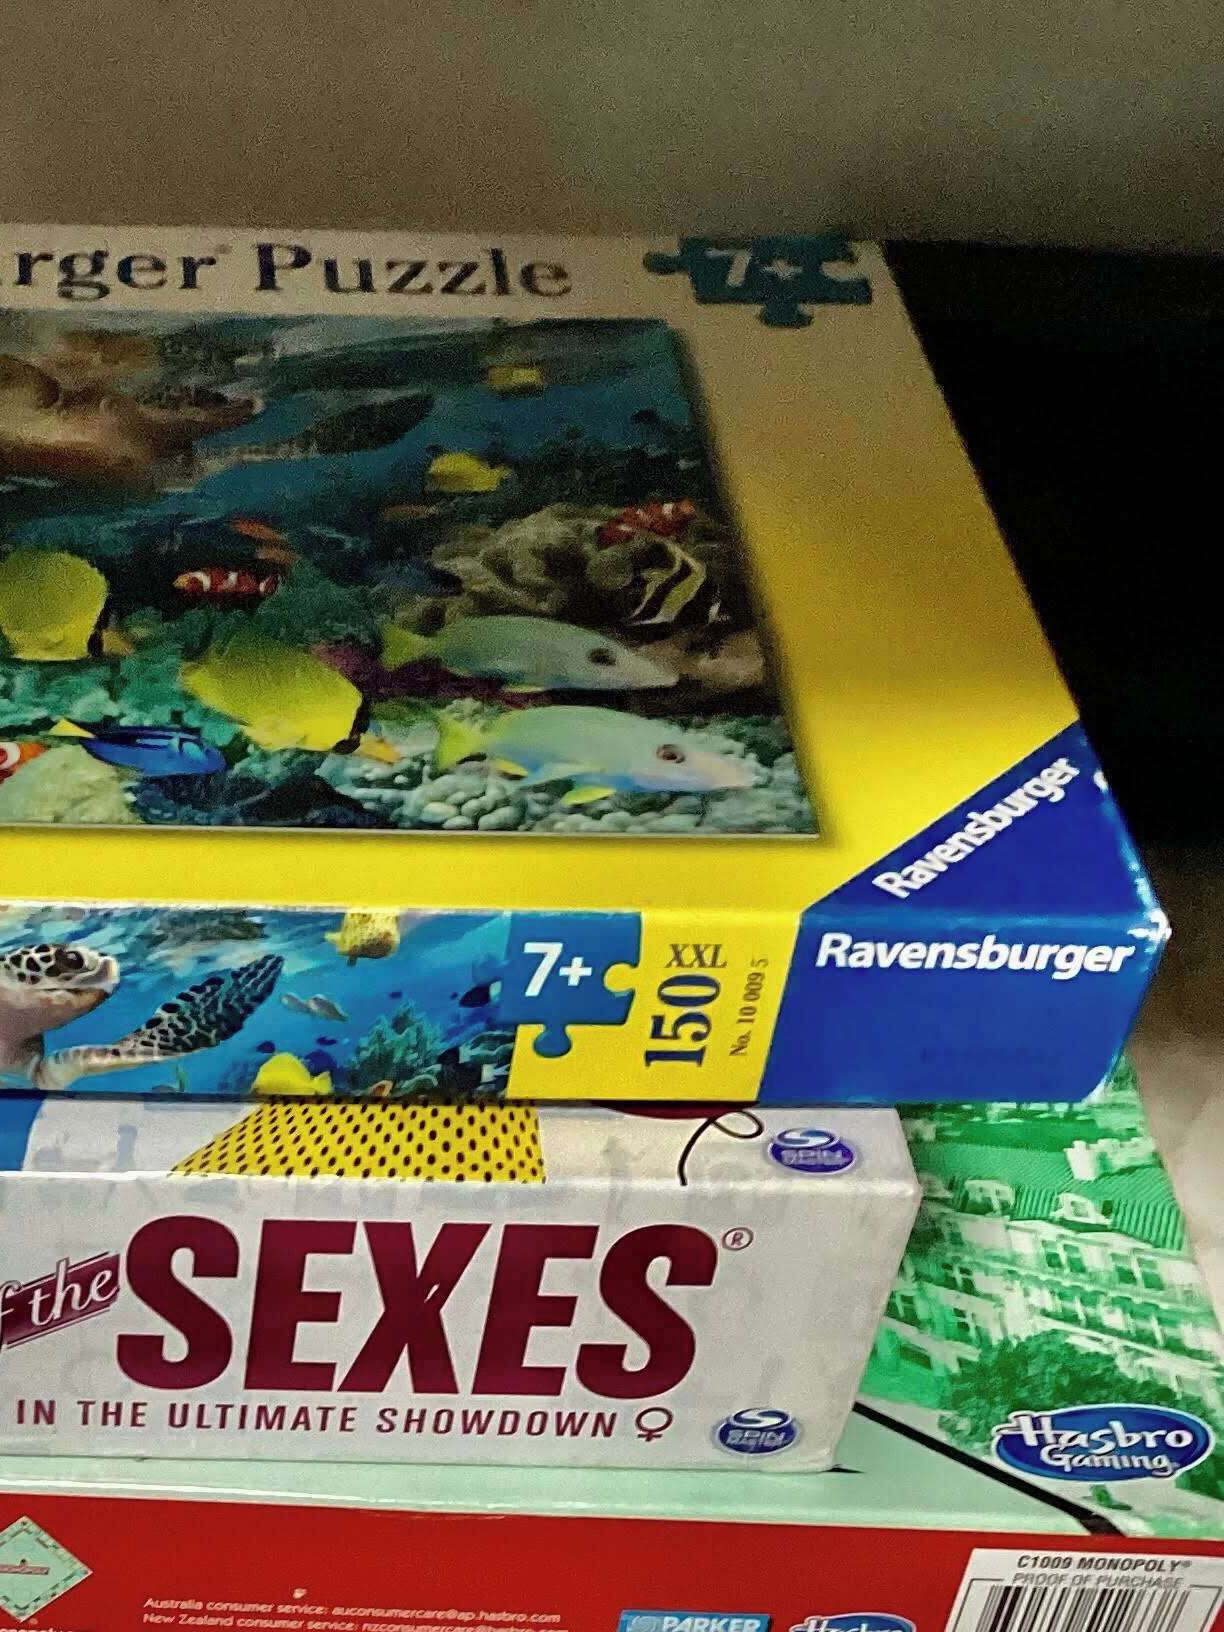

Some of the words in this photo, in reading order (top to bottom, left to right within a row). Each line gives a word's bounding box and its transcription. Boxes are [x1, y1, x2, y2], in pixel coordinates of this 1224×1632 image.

[253, 243, 573, 299] Puzzle
[872, 758, 1080, 899] Ravensburger
[523, 941, 592, 998] 7+
[664, 943, 728, 969] XXL
[816, 931, 1136, 980] Ravensburger
[644, 974, 722, 1068] 150
[736, 1005, 757, 1025] 10
[728, 1029, 753, 1057] No.
[28, 1257, 120, 1327] the
[17, 1398, 56, 1426] IN
[78, 1400, 148, 1428] THE
[167, 1402, 358, 1433] ULTIMATE
[377, 1407, 618, 1439] SHOWDOWN
[997, 1415, 1194, 1454] Hasbro
[1040, 1444, 1175, 1477] Gaming
[1012, 1572, 1067, 1585] PROOF
[1072, 1573, 1089, 1586] OF
[1096, 1575, 1185, 1589] PURCHASE
[1017, 1555, 1073, 1570] C1009
[143, 1598, 203, 1610] Australia
[206, 1601, 276, 1613] consumer
[278, 1604, 328, 1615] service:
[143, 1613, 176, 1624] New
[179, 1613, 234, 1627] Zealand
[237, 1618, 305, 1629] consumer
